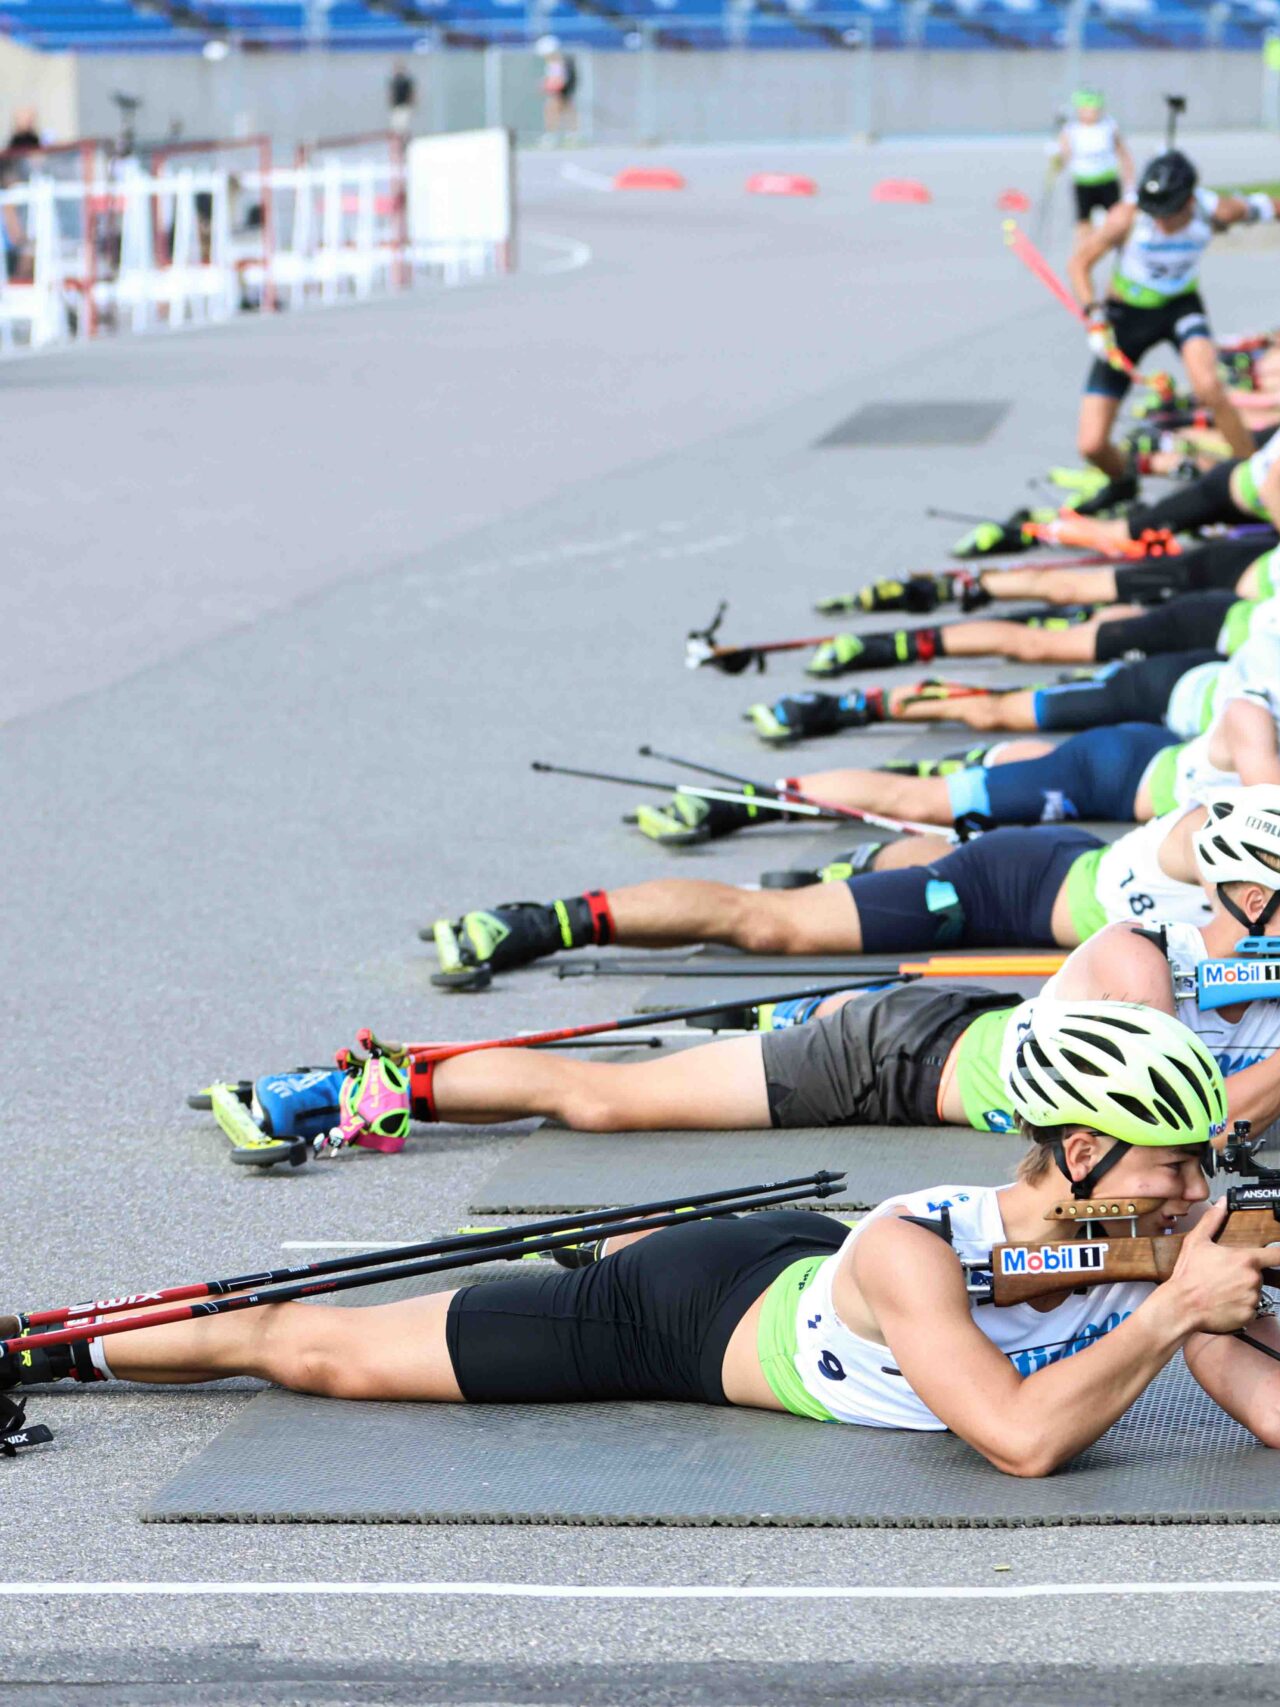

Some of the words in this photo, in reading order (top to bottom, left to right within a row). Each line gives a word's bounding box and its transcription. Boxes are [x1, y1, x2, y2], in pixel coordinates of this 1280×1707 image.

[1206, 965, 1260, 983] Mobil
[1267, 965, 1279, 981] 1
[1003, 1247, 1074, 1272] Mobil
[1082, 1247, 1099, 1267] 1
